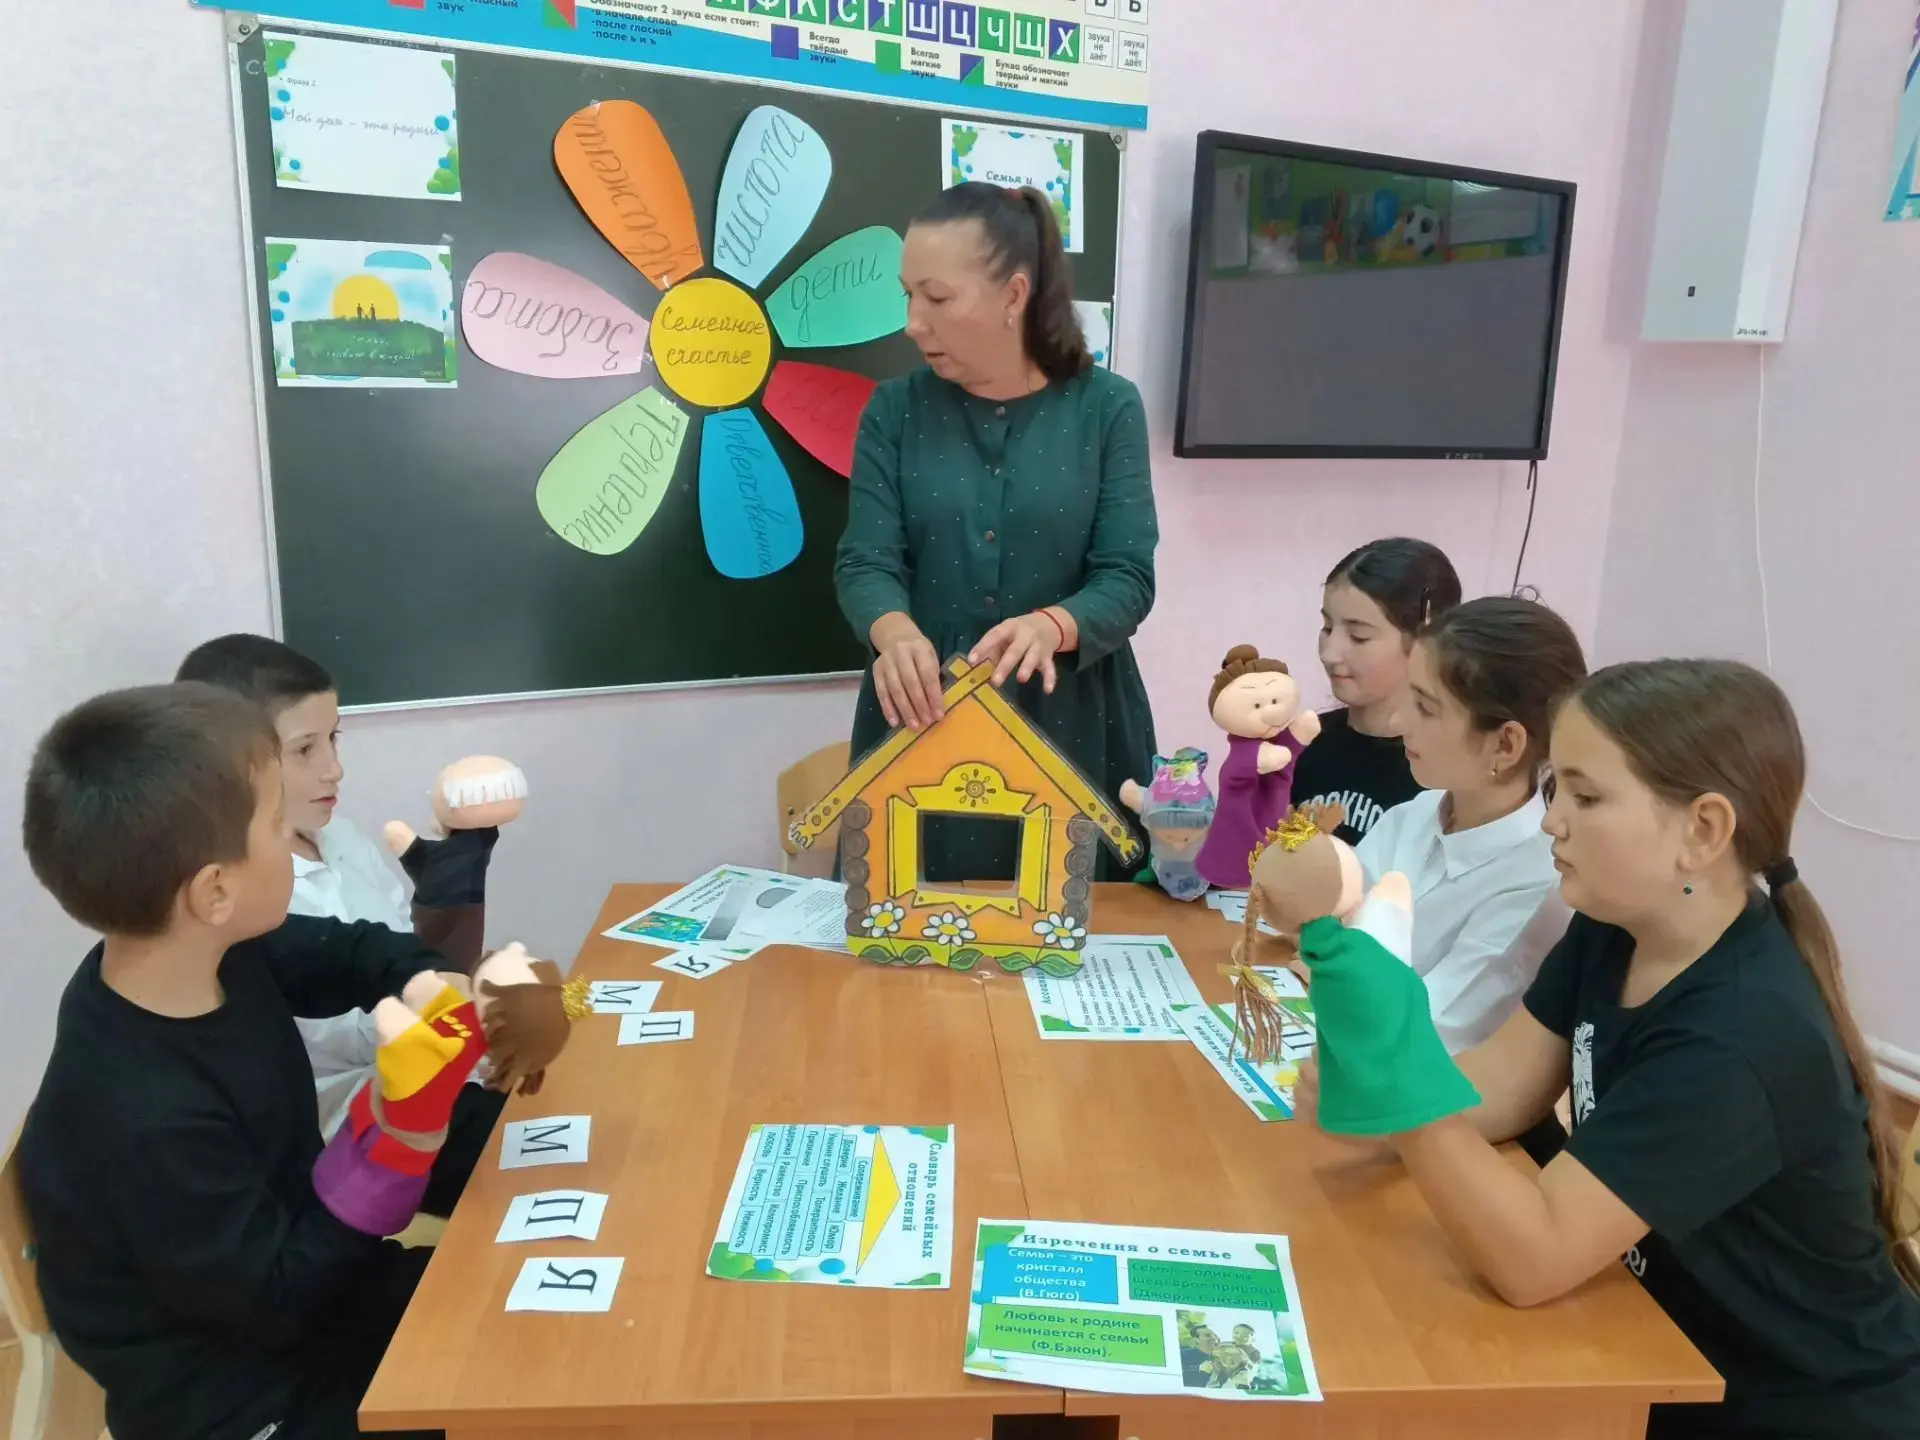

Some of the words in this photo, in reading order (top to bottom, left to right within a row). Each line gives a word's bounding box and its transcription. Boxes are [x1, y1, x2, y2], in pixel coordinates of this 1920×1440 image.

[436, 2, 465, 16] звук
[604, 10, 645, 22] начале
[647, 15, 678, 27] слова
[661, 4, 668, 14] 2
[671, 8, 701, 20] звука
[704, 13, 728, 23] если
[730, 17, 760, 28] стоит:
[838, 0, 858, 23] С
[878, 0, 896, 28] Т
[909, 1, 937, 34] Ш
[630, 24, 673, 37] гласной
[809, 31, 840, 44] Всегда
[950, 9, 971, 46] Ц
[987, 16, 1004, 47] Ч
[1016, 20, 1044, 58] Щ
[1088, 31, 1110, 43] звука
[809, 42, 849, 56] твёрдые
[910, 47, 940, 60] Всегда
[1056, 27, 1074, 58] Х
[1093, 43, 1104, 51] не
[1123, 39, 1145, 49] звука
[1128, 49, 1140, 58] не
[809, 53, 837, 65] звуки
[910, 59, 942, 71] мягкие
[995, 59, 1020, 72] Буква
[1022, 64, 1070, 78] обозначает
[910, 69, 936, 80] звуки
[995, 79, 1019, 90] звуки
[1039, 76, 1069, 88] мягкий
[986, 170, 1022, 185] Семья
[1025, 177, 1033, 186] и
[470, 280, 634, 371] Забота
[661, 306, 766, 335] Семейное
[561, 403, 681, 553] Терпение
[592, 984, 642, 1006] М
[640, 1018, 682, 1039] П
[520, 1121, 571, 1158] М
[802, 1130, 819, 1167] Признание
[818, 1158, 832, 1187] слушать
[927, 1143, 942, 1189] Словарь
[749, 1169, 766, 1202] Верность
[775, 1160, 791, 1197] Равенство
[849, 1160, 868, 1218] Сопереживание
[834, 1180, 848, 1215] Желание
[902, 1162, 918, 1232] отношений
[525, 1196, 585, 1228] П
[781, 1179, 808, 1255] Приспособляемость
[734, 1211, 750, 1248] Нежность
[758, 1204, 780, 1253] Компромисс
[805, 1196, 826, 1252] Толерантность
[922, 1193, 935, 1258] семейных
[824, 1225, 839, 1250] Юмор
[1022, 1234, 1139, 1254] Изречения
[1148, 1245, 1159, 1255] о
[1168, 1243, 1233, 1261] семье
[1008, 1247, 1055, 1260] Семья
[1071, 1254, 1095, 1263] это
[537, 1261, 598, 1295] Я
[1016, 1262, 1085, 1276] кристалл
[1131, 1261, 1178, 1275] Семья
[1014, 1275, 1087, 1288] общества
[1211, 1283, 1282, 1297] природы
[1018, 1287, 1081, 1303] (В.Гюго)
[1003, 1310, 1066, 1324] Любовь
[1069, 1315, 1079, 1324] к
[1082, 1317, 1142, 1330] родине
[994, 1323, 1085, 1341] начинается
[1088, 1331, 1097, 1341] с
[1100, 1333, 1150, 1346] семьи
